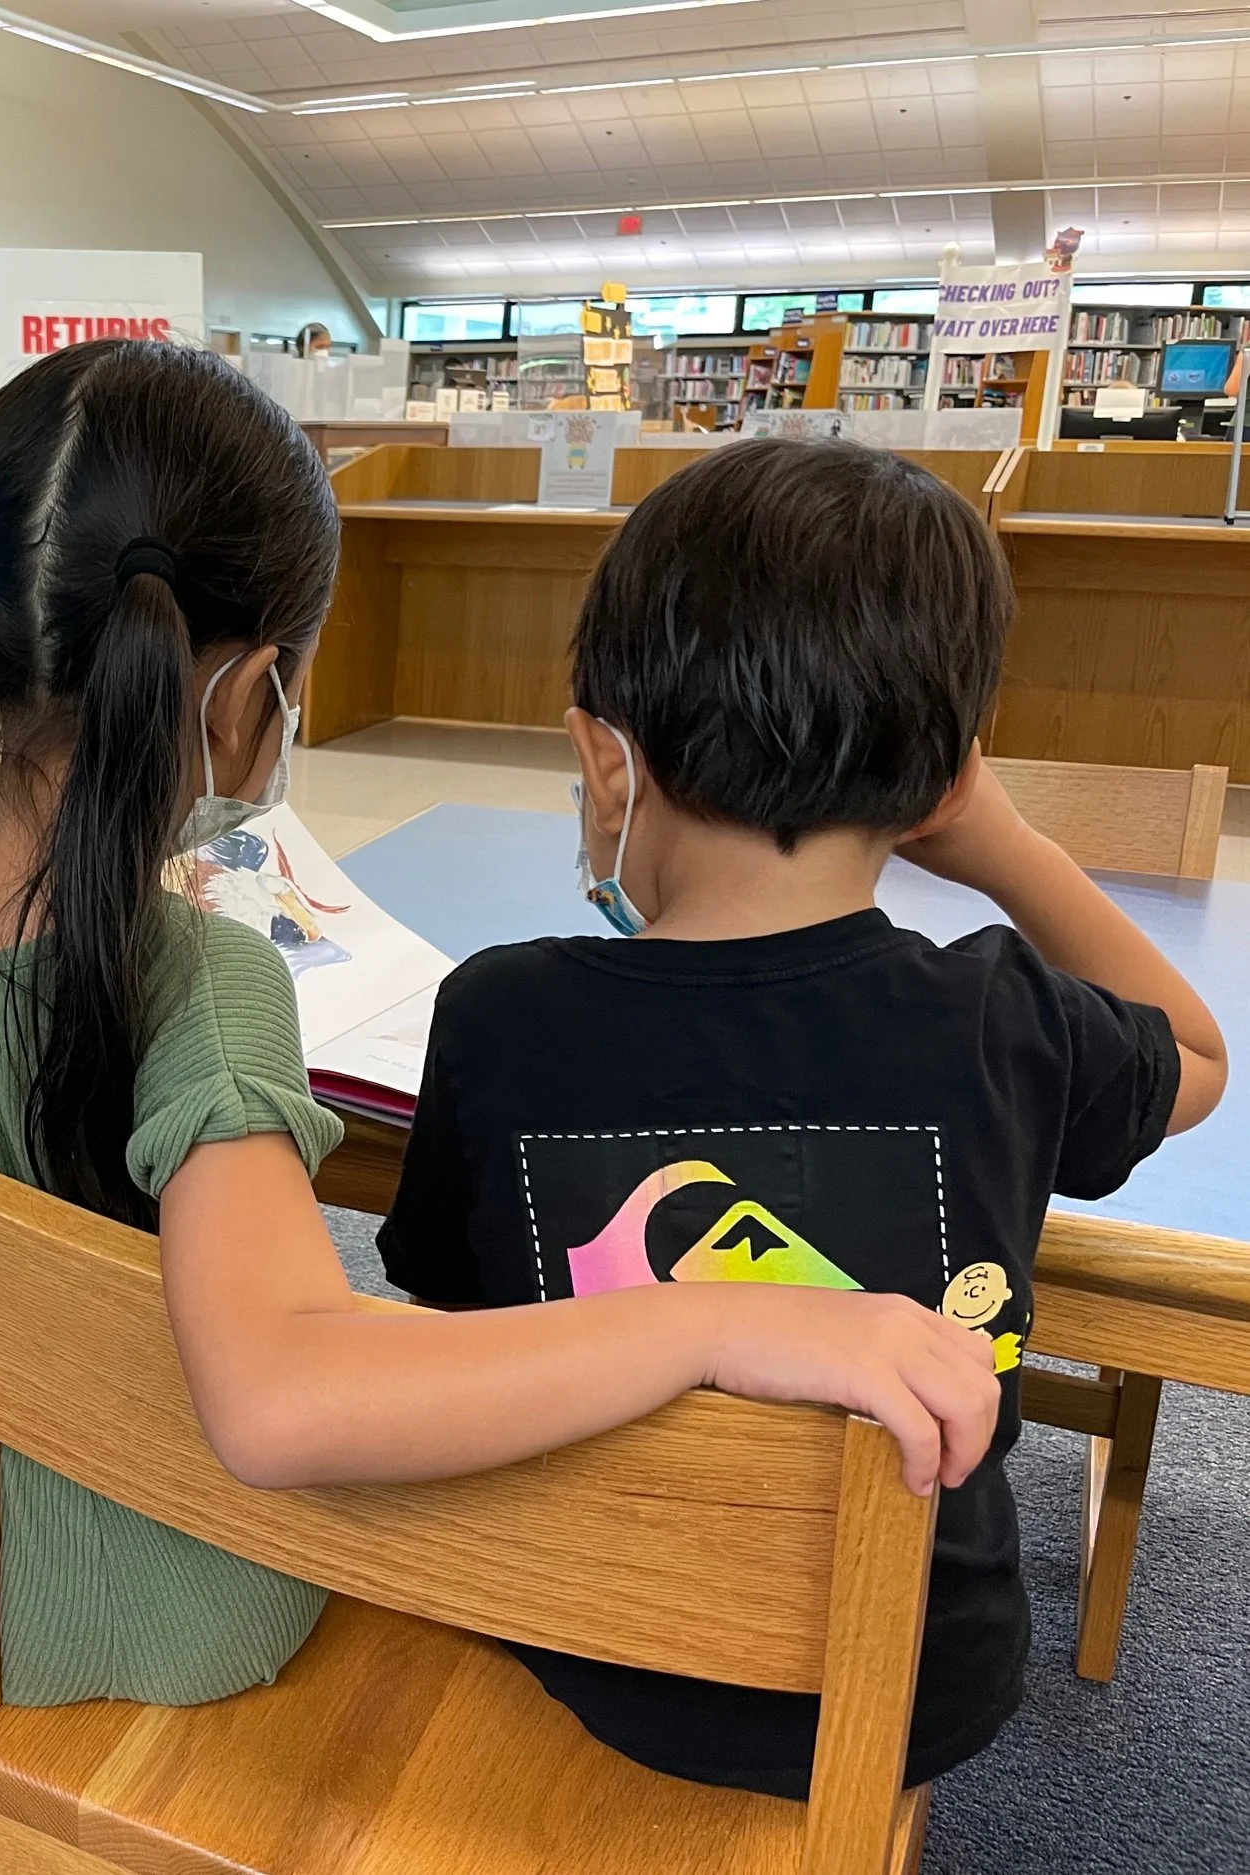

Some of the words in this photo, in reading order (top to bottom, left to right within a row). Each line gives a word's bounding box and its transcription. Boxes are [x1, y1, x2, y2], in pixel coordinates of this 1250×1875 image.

[1022, 279, 1061, 300] OUT?
[21, 316, 172, 354] RETURNS
[978, 318, 1020, 337] OVER
[1019, 315, 1060, 335] HERE
